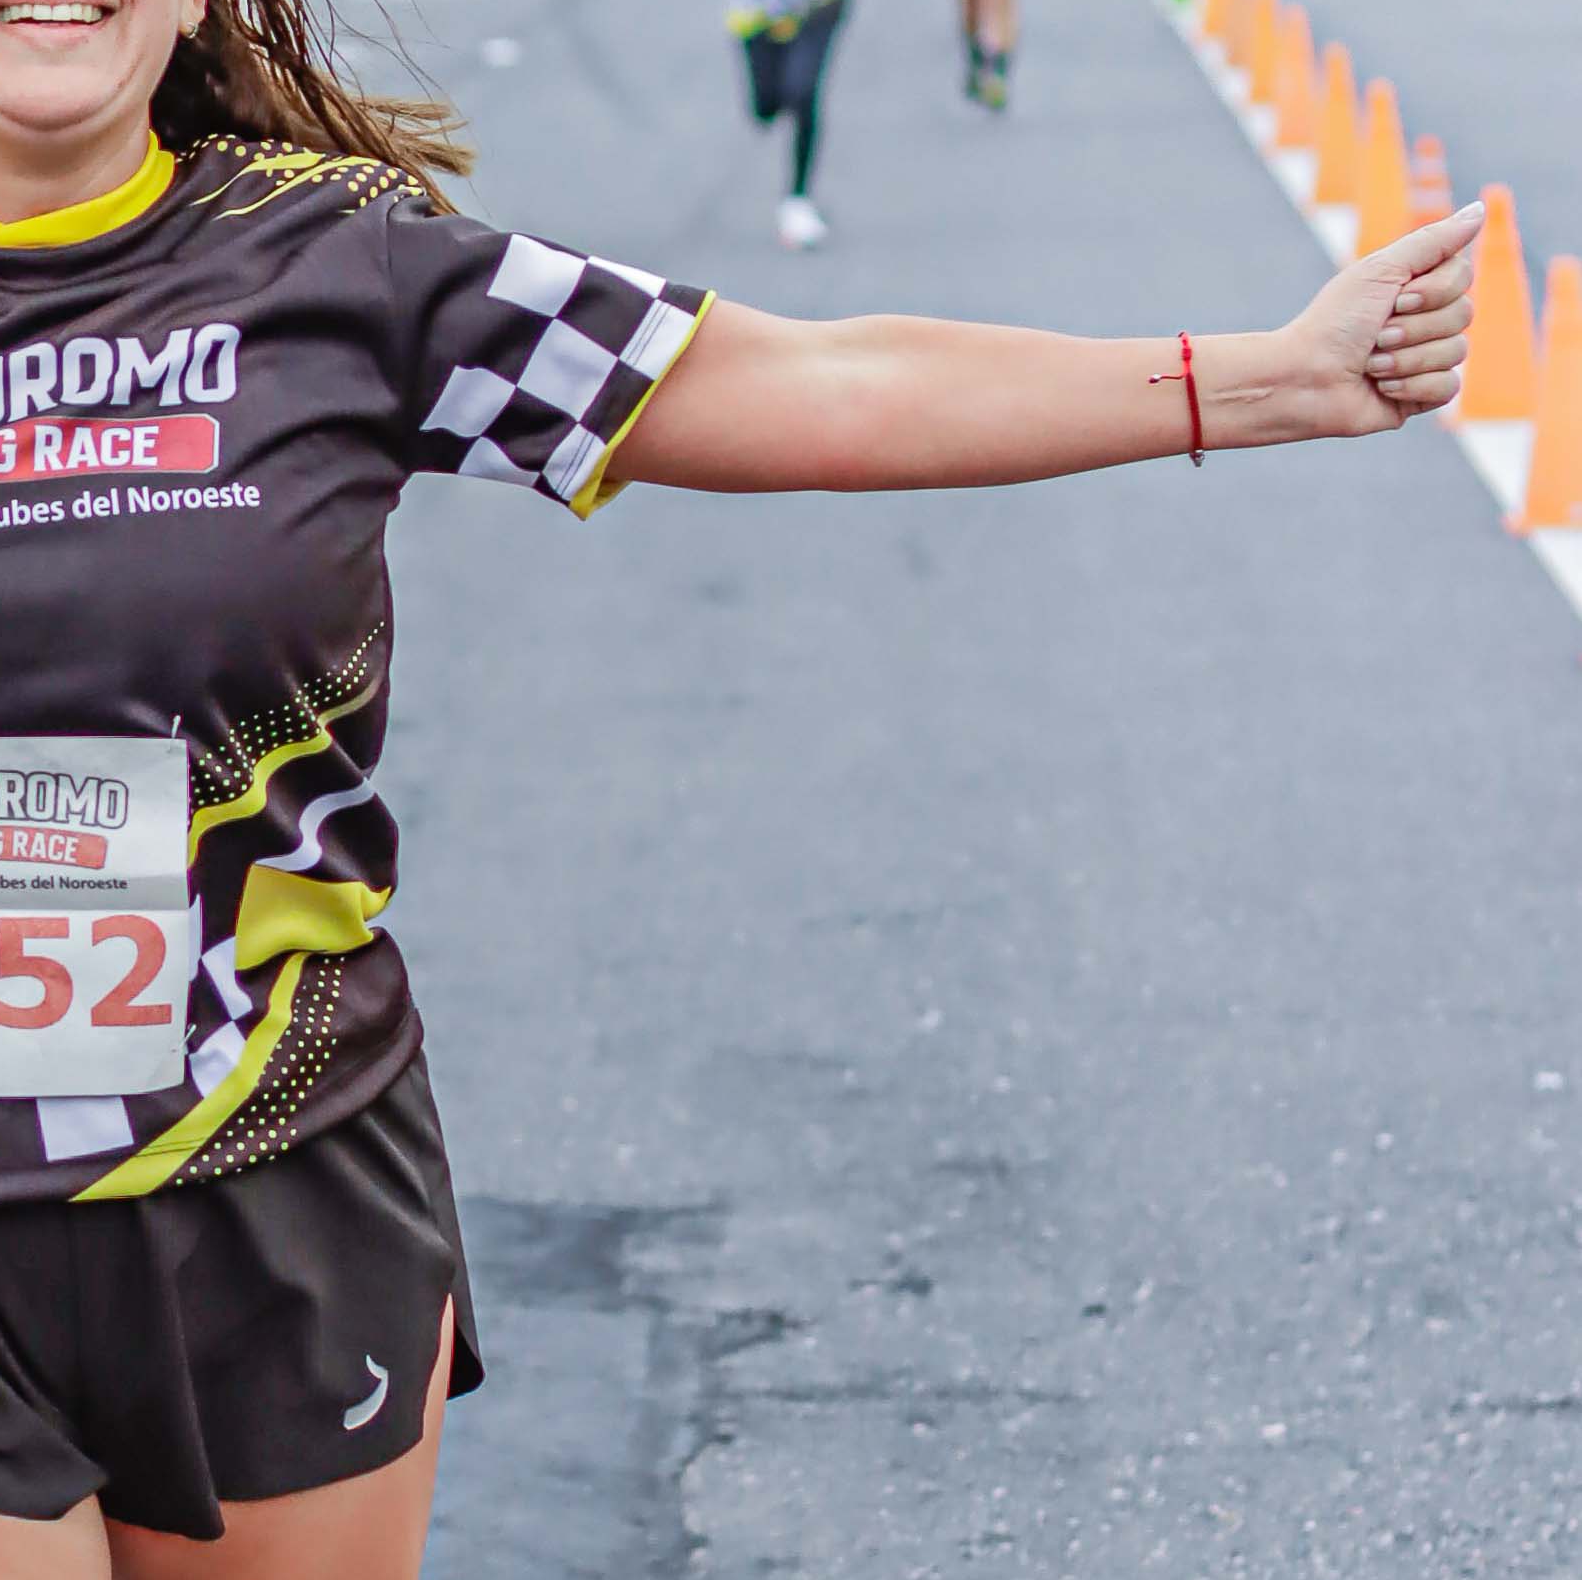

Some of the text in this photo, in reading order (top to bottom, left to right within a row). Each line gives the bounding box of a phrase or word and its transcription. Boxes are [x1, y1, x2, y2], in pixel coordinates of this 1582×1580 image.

[32, 425, 161, 470] RACE
[72, 488, 120, 520] del
[127, 482, 261, 514] Noroeste
[12, 830, 80, 864] RACE
[30, 874, 55, 890] del
[59, 875, 129, 890] Noroeste
